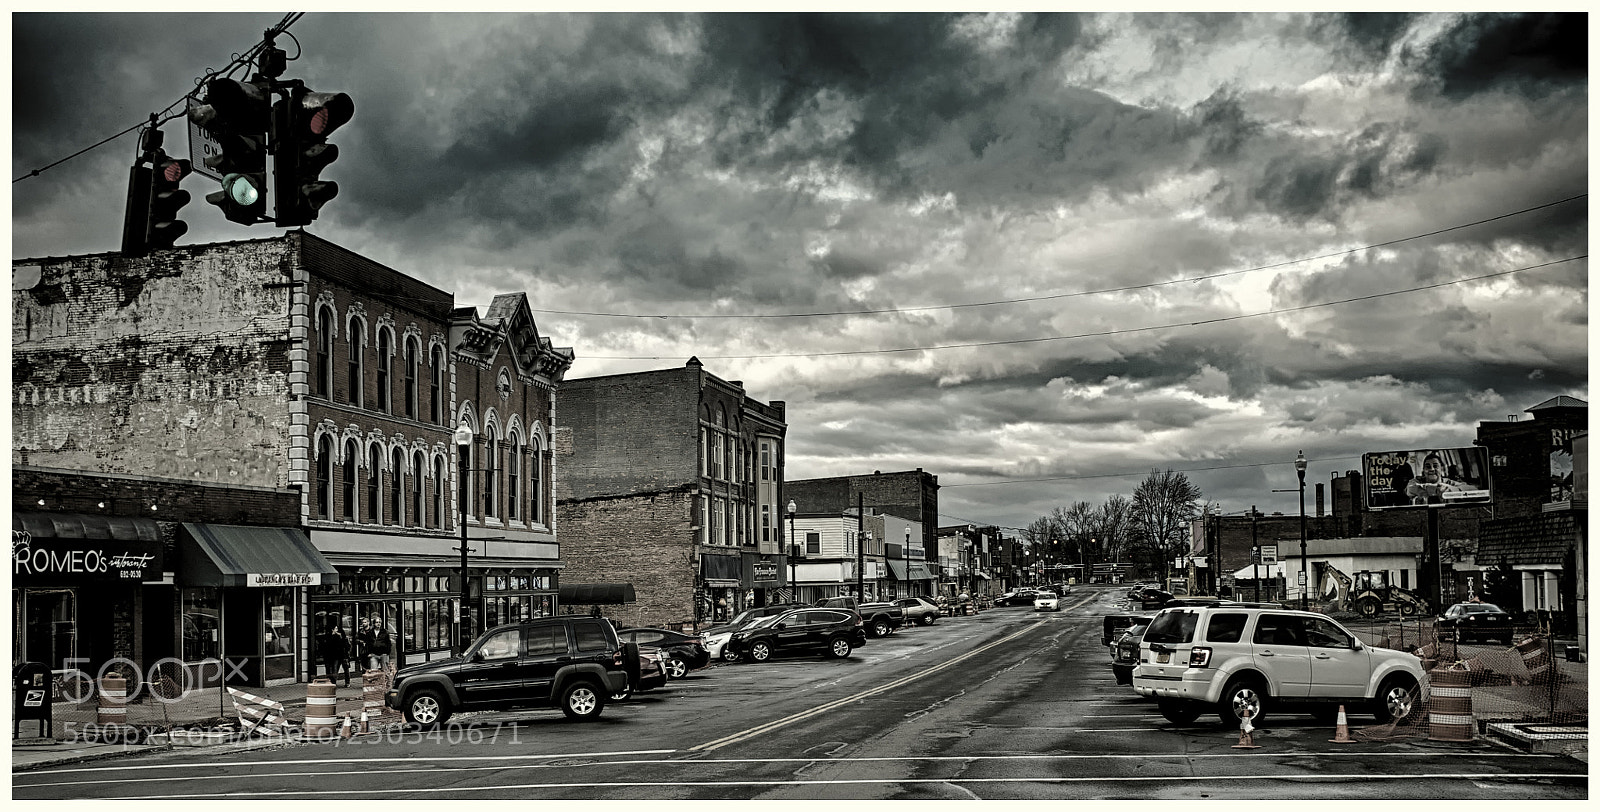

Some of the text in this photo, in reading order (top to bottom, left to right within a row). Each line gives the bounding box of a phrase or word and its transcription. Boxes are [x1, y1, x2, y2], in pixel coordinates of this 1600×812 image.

[203, 144, 218, 156] ON
[1370, 465, 1391, 476] the
[1371, 476, 1393, 487] day
